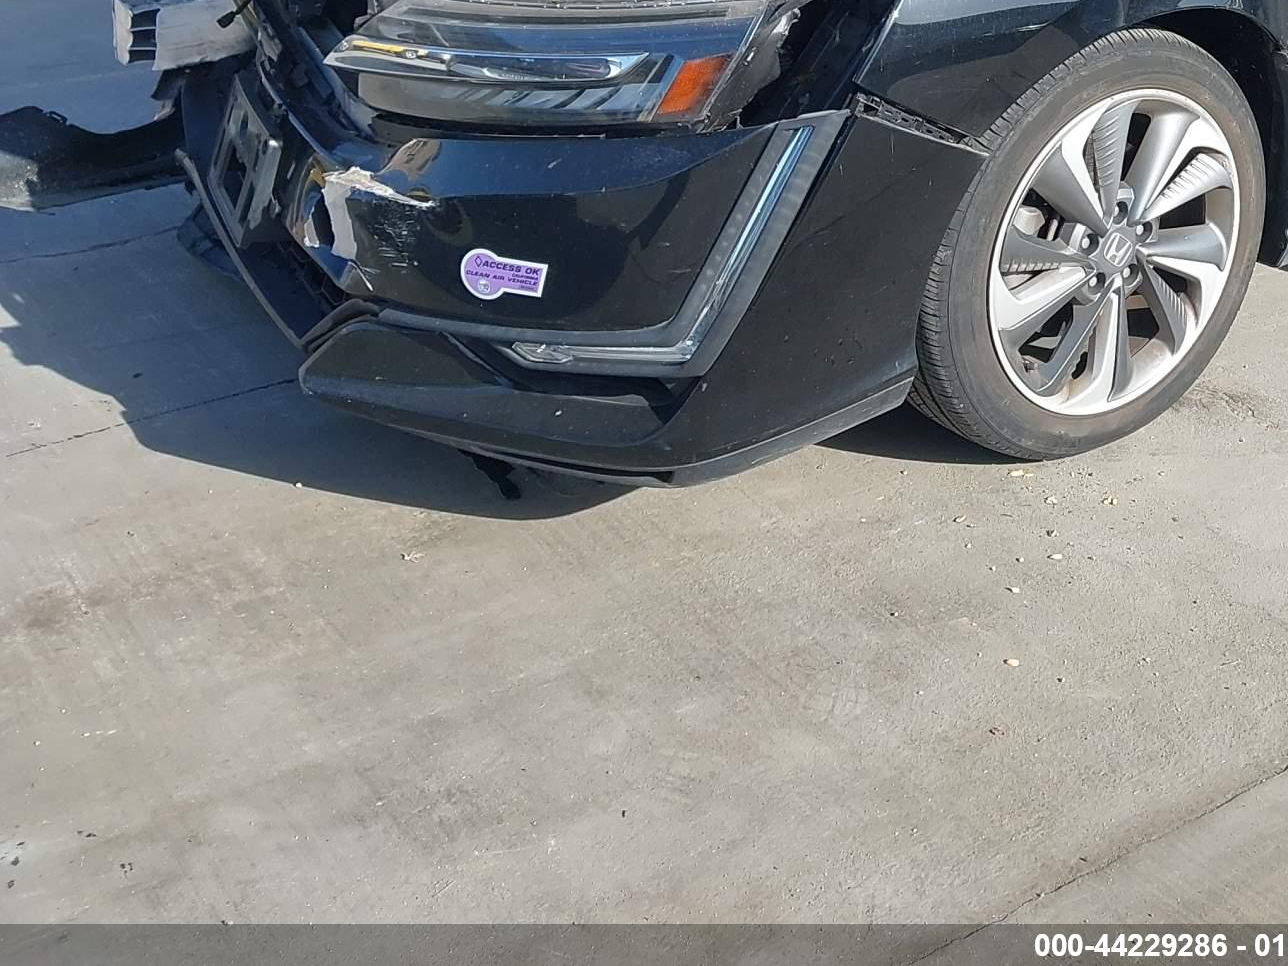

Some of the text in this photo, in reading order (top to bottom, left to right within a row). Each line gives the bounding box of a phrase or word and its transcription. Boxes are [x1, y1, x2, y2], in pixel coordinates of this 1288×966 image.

[482, 260, 541, 276] ACCESS OK
[466, 269, 491, 279] CLEAN
[507, 276, 538, 286] VEHICLE
